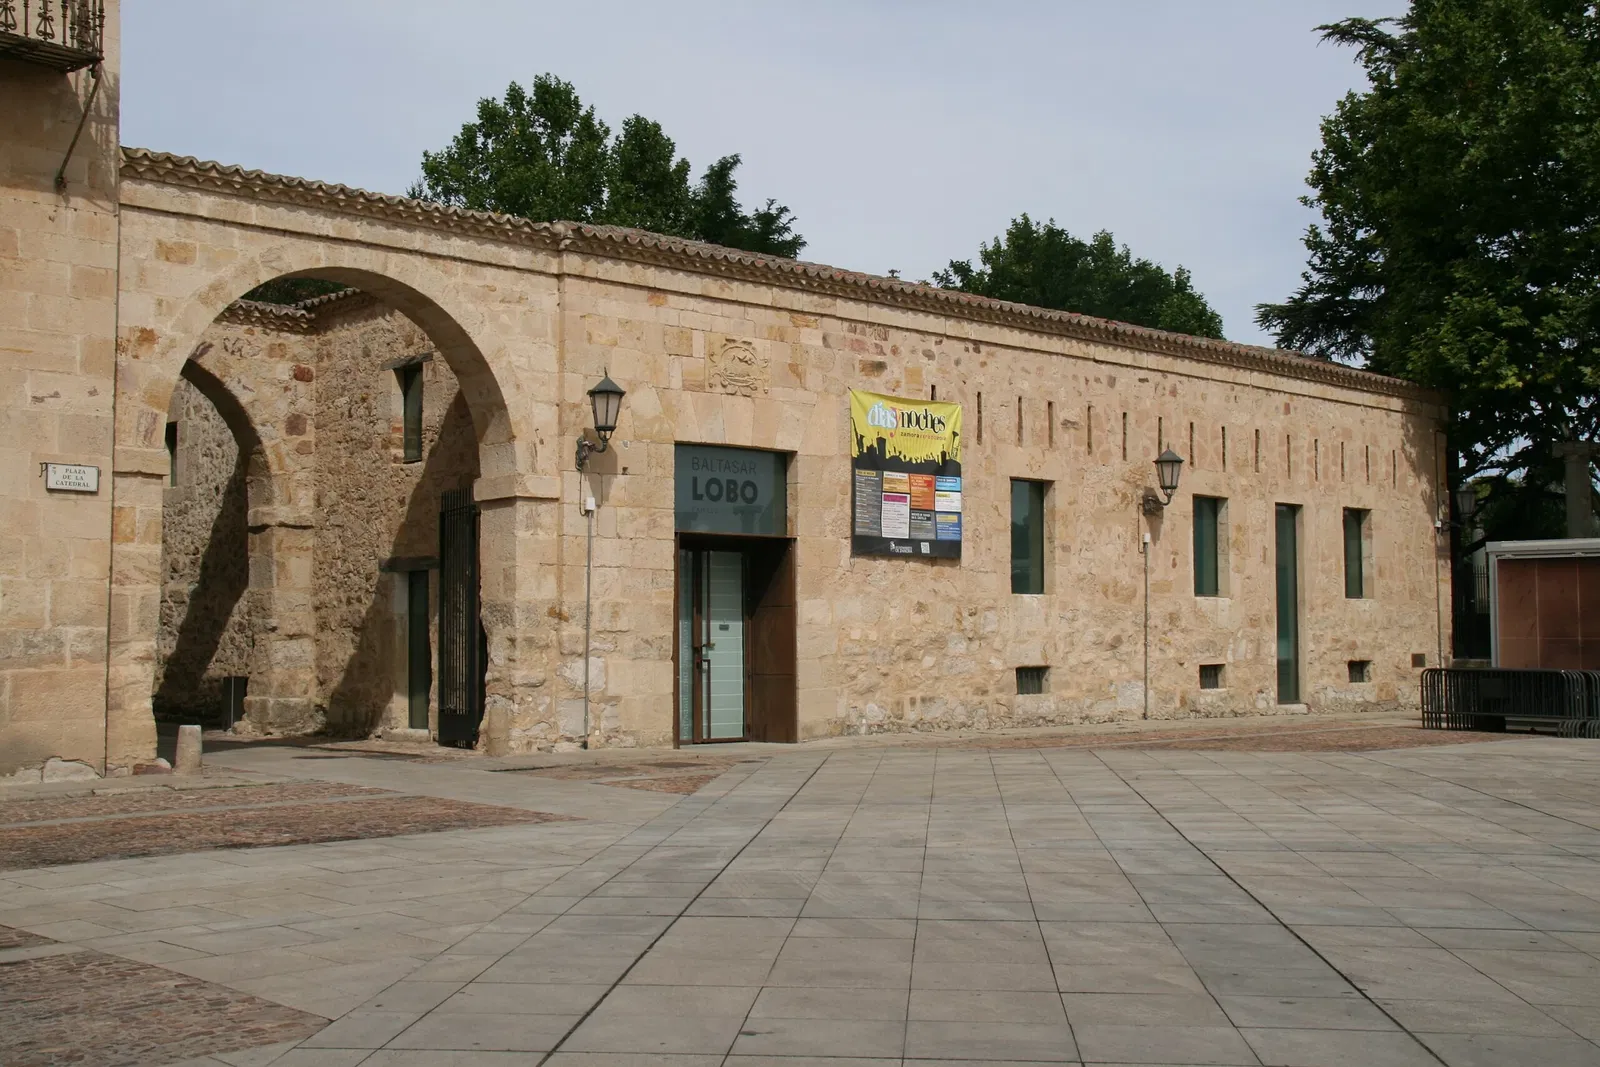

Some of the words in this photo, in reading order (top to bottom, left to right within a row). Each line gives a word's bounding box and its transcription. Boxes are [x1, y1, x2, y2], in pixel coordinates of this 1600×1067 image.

[901, 408, 946, 433] noches
[691, 456, 757, 475] BALTASAR
[692, 476, 758, 504] LOBO
